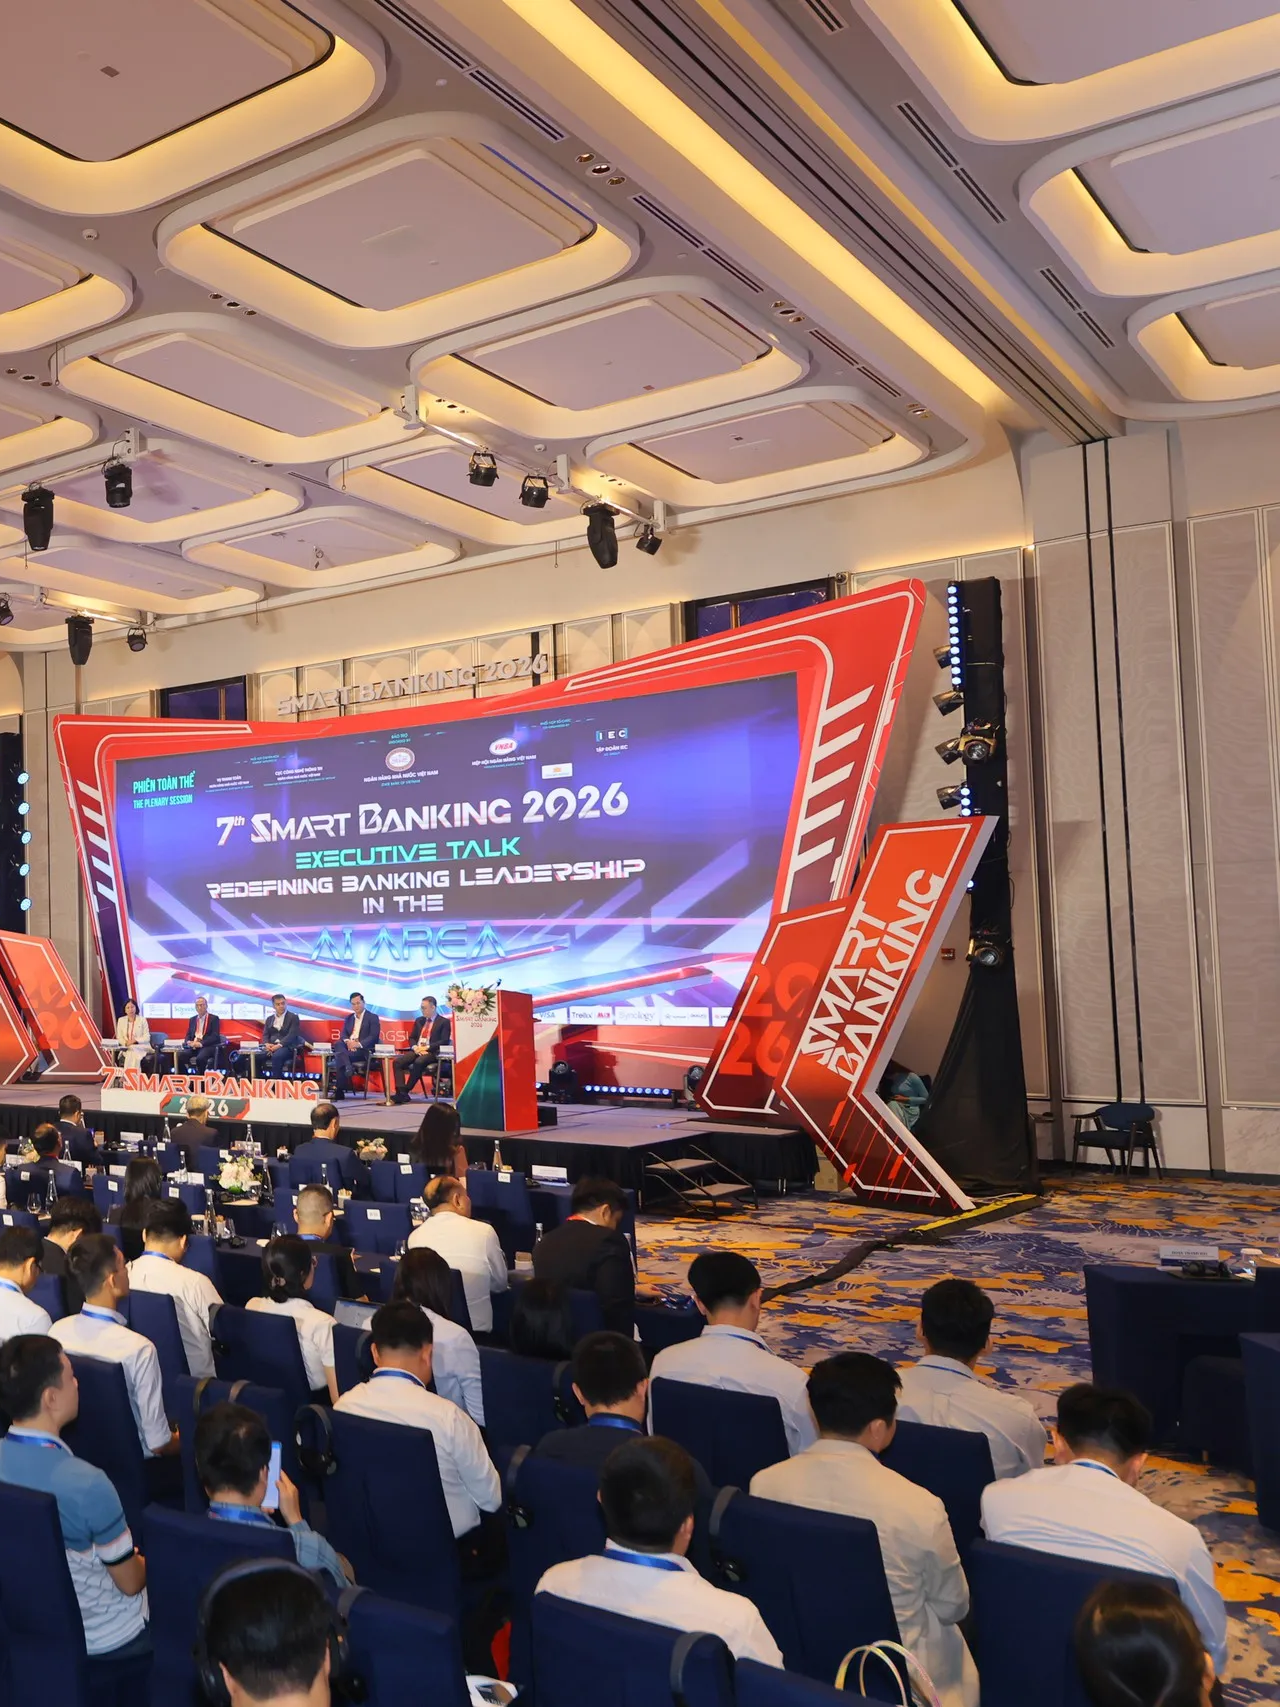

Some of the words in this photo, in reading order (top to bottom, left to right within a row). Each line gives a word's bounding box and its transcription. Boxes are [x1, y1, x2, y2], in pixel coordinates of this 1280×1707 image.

[277, 686, 353, 716] SMART
[360, 667, 476, 702] BANKING
[482, 653, 549, 682] 2026
[133, 777, 156, 794] PHIÊN
[158, 774, 178, 791] TOÀN
[179, 770, 196, 788] THỂ
[133, 799, 144, 809] THE
[144, 796, 169, 808] PLENARY
[169, 794, 193, 805] SESSION
[216, 814, 245, 846] 7th
[250, 812, 352, 843] SMART
[358, 798, 512, 836] BANKING
[522, 783, 629, 824] 2026
[295, 842, 437, 870] EXECUTIVE
[447, 836, 521, 859] TALK
[206, 876, 333, 899] REDEFINING
[342, 869, 450, 892] BANKING
[459, 859, 646, 887] LEADERSHIP
[363, 897, 385, 914] IN
[393, 894, 444, 912] THE
[310, 928, 354, 961] AI
[368, 921, 507, 961] AREA
[800, 901, 887, 1067] SMART
[827, 869, 945, 1083] BANKING
[179, 1097, 229, 1117] 226
